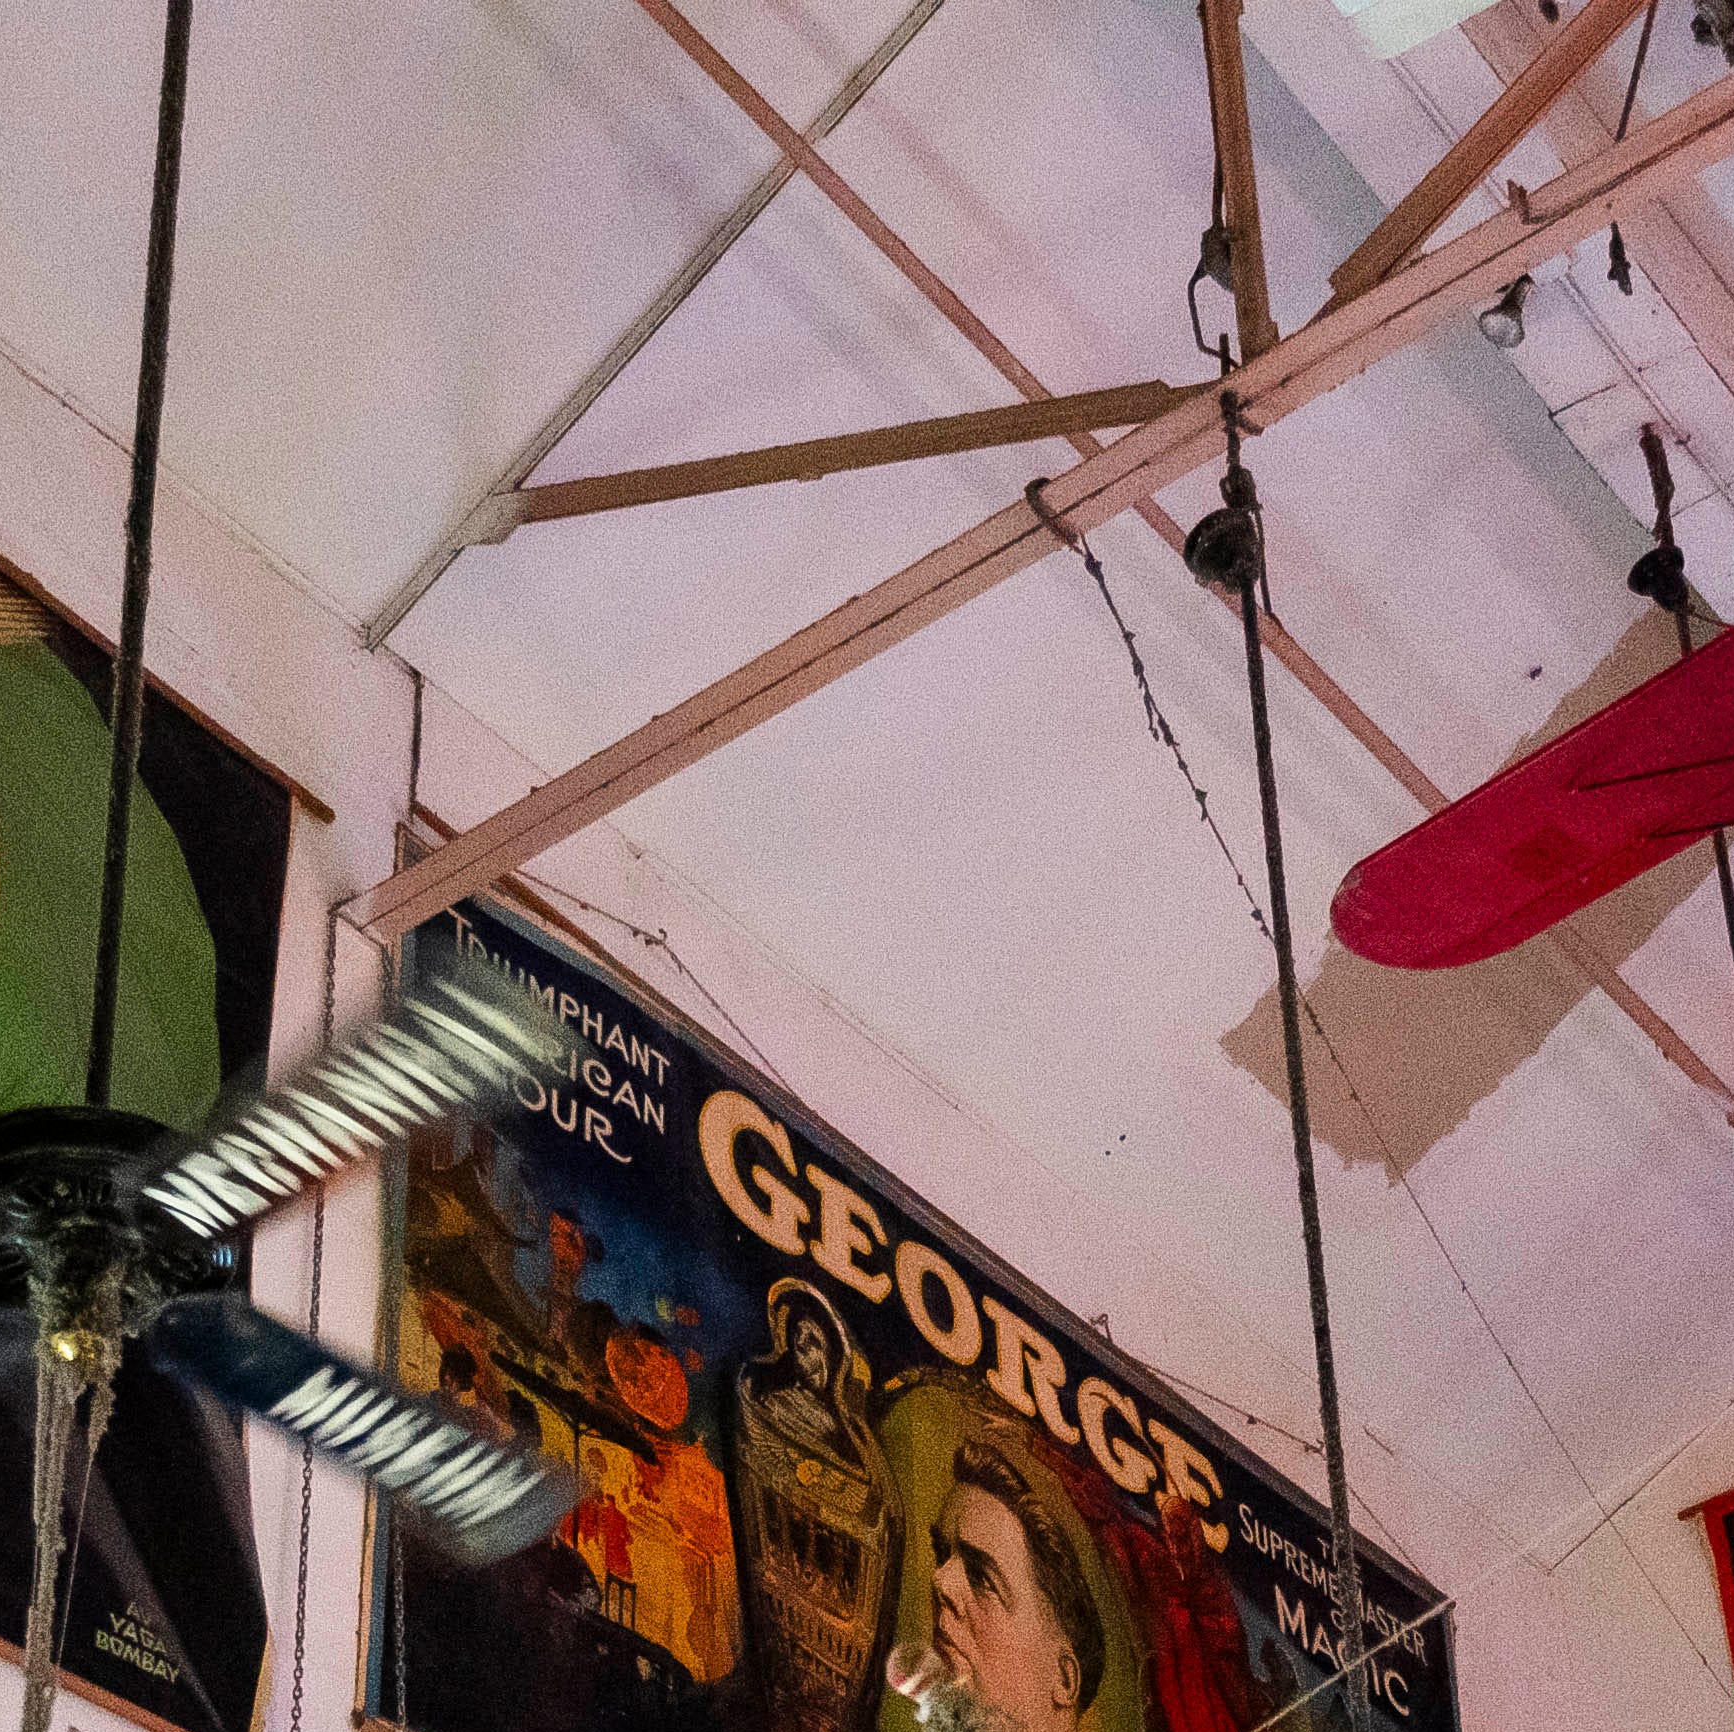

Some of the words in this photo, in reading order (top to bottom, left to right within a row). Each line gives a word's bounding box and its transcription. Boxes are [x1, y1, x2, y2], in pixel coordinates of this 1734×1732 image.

[514, 1074, 633, 1164] OUR
[698, 1090, 1229, 1555] GEORGE
[95, 1629, 180, 1683] BOMBAY
